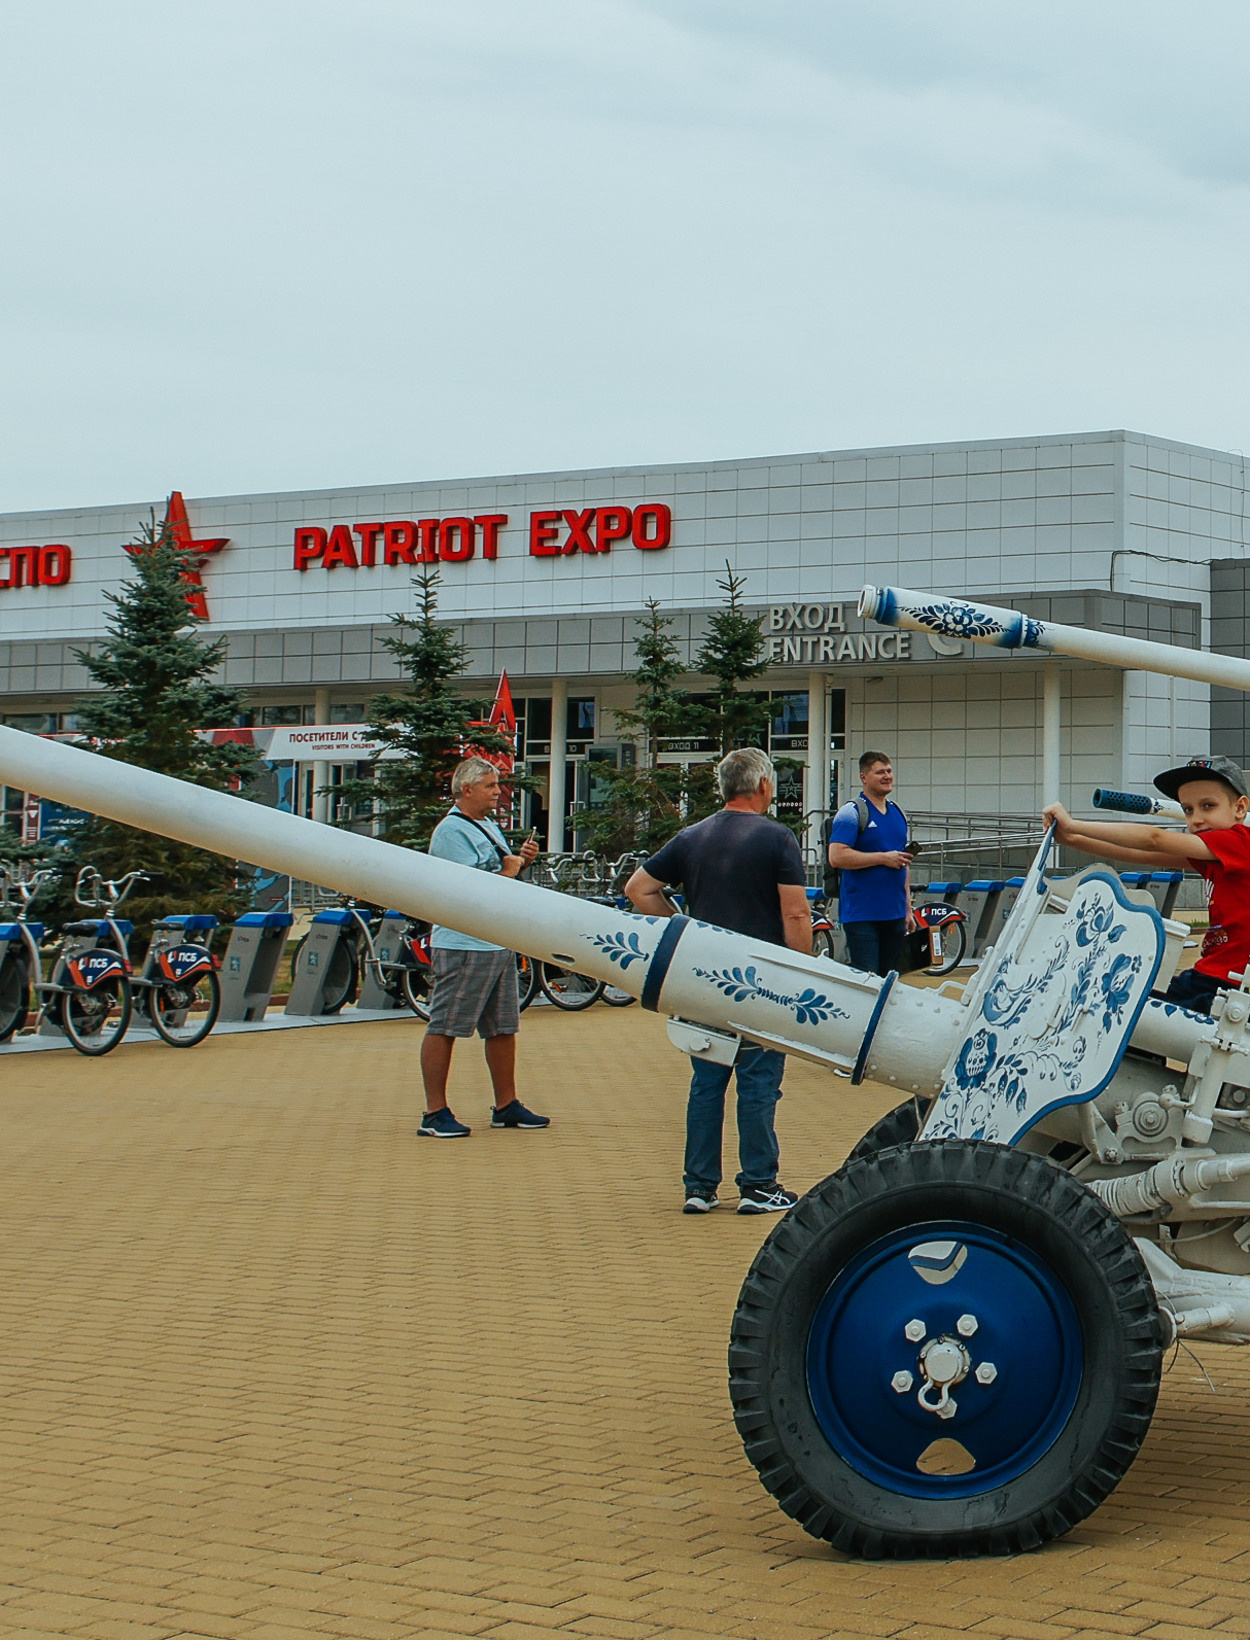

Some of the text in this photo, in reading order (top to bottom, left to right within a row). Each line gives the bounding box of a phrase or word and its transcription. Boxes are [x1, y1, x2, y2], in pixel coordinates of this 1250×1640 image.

[294, 503, 671, 570] PATRIOT EXPO
[769, 602, 846, 632] ВХОД
[769, 632, 911, 662] ENTRANCE
[289, 731, 349, 743] ПОСЕТИТЕЛИ
[931, 908, 947, 916] ПСБ
[89, 958, 108, 968] ПСБ
[178, 952, 197, 962] ПСБ
